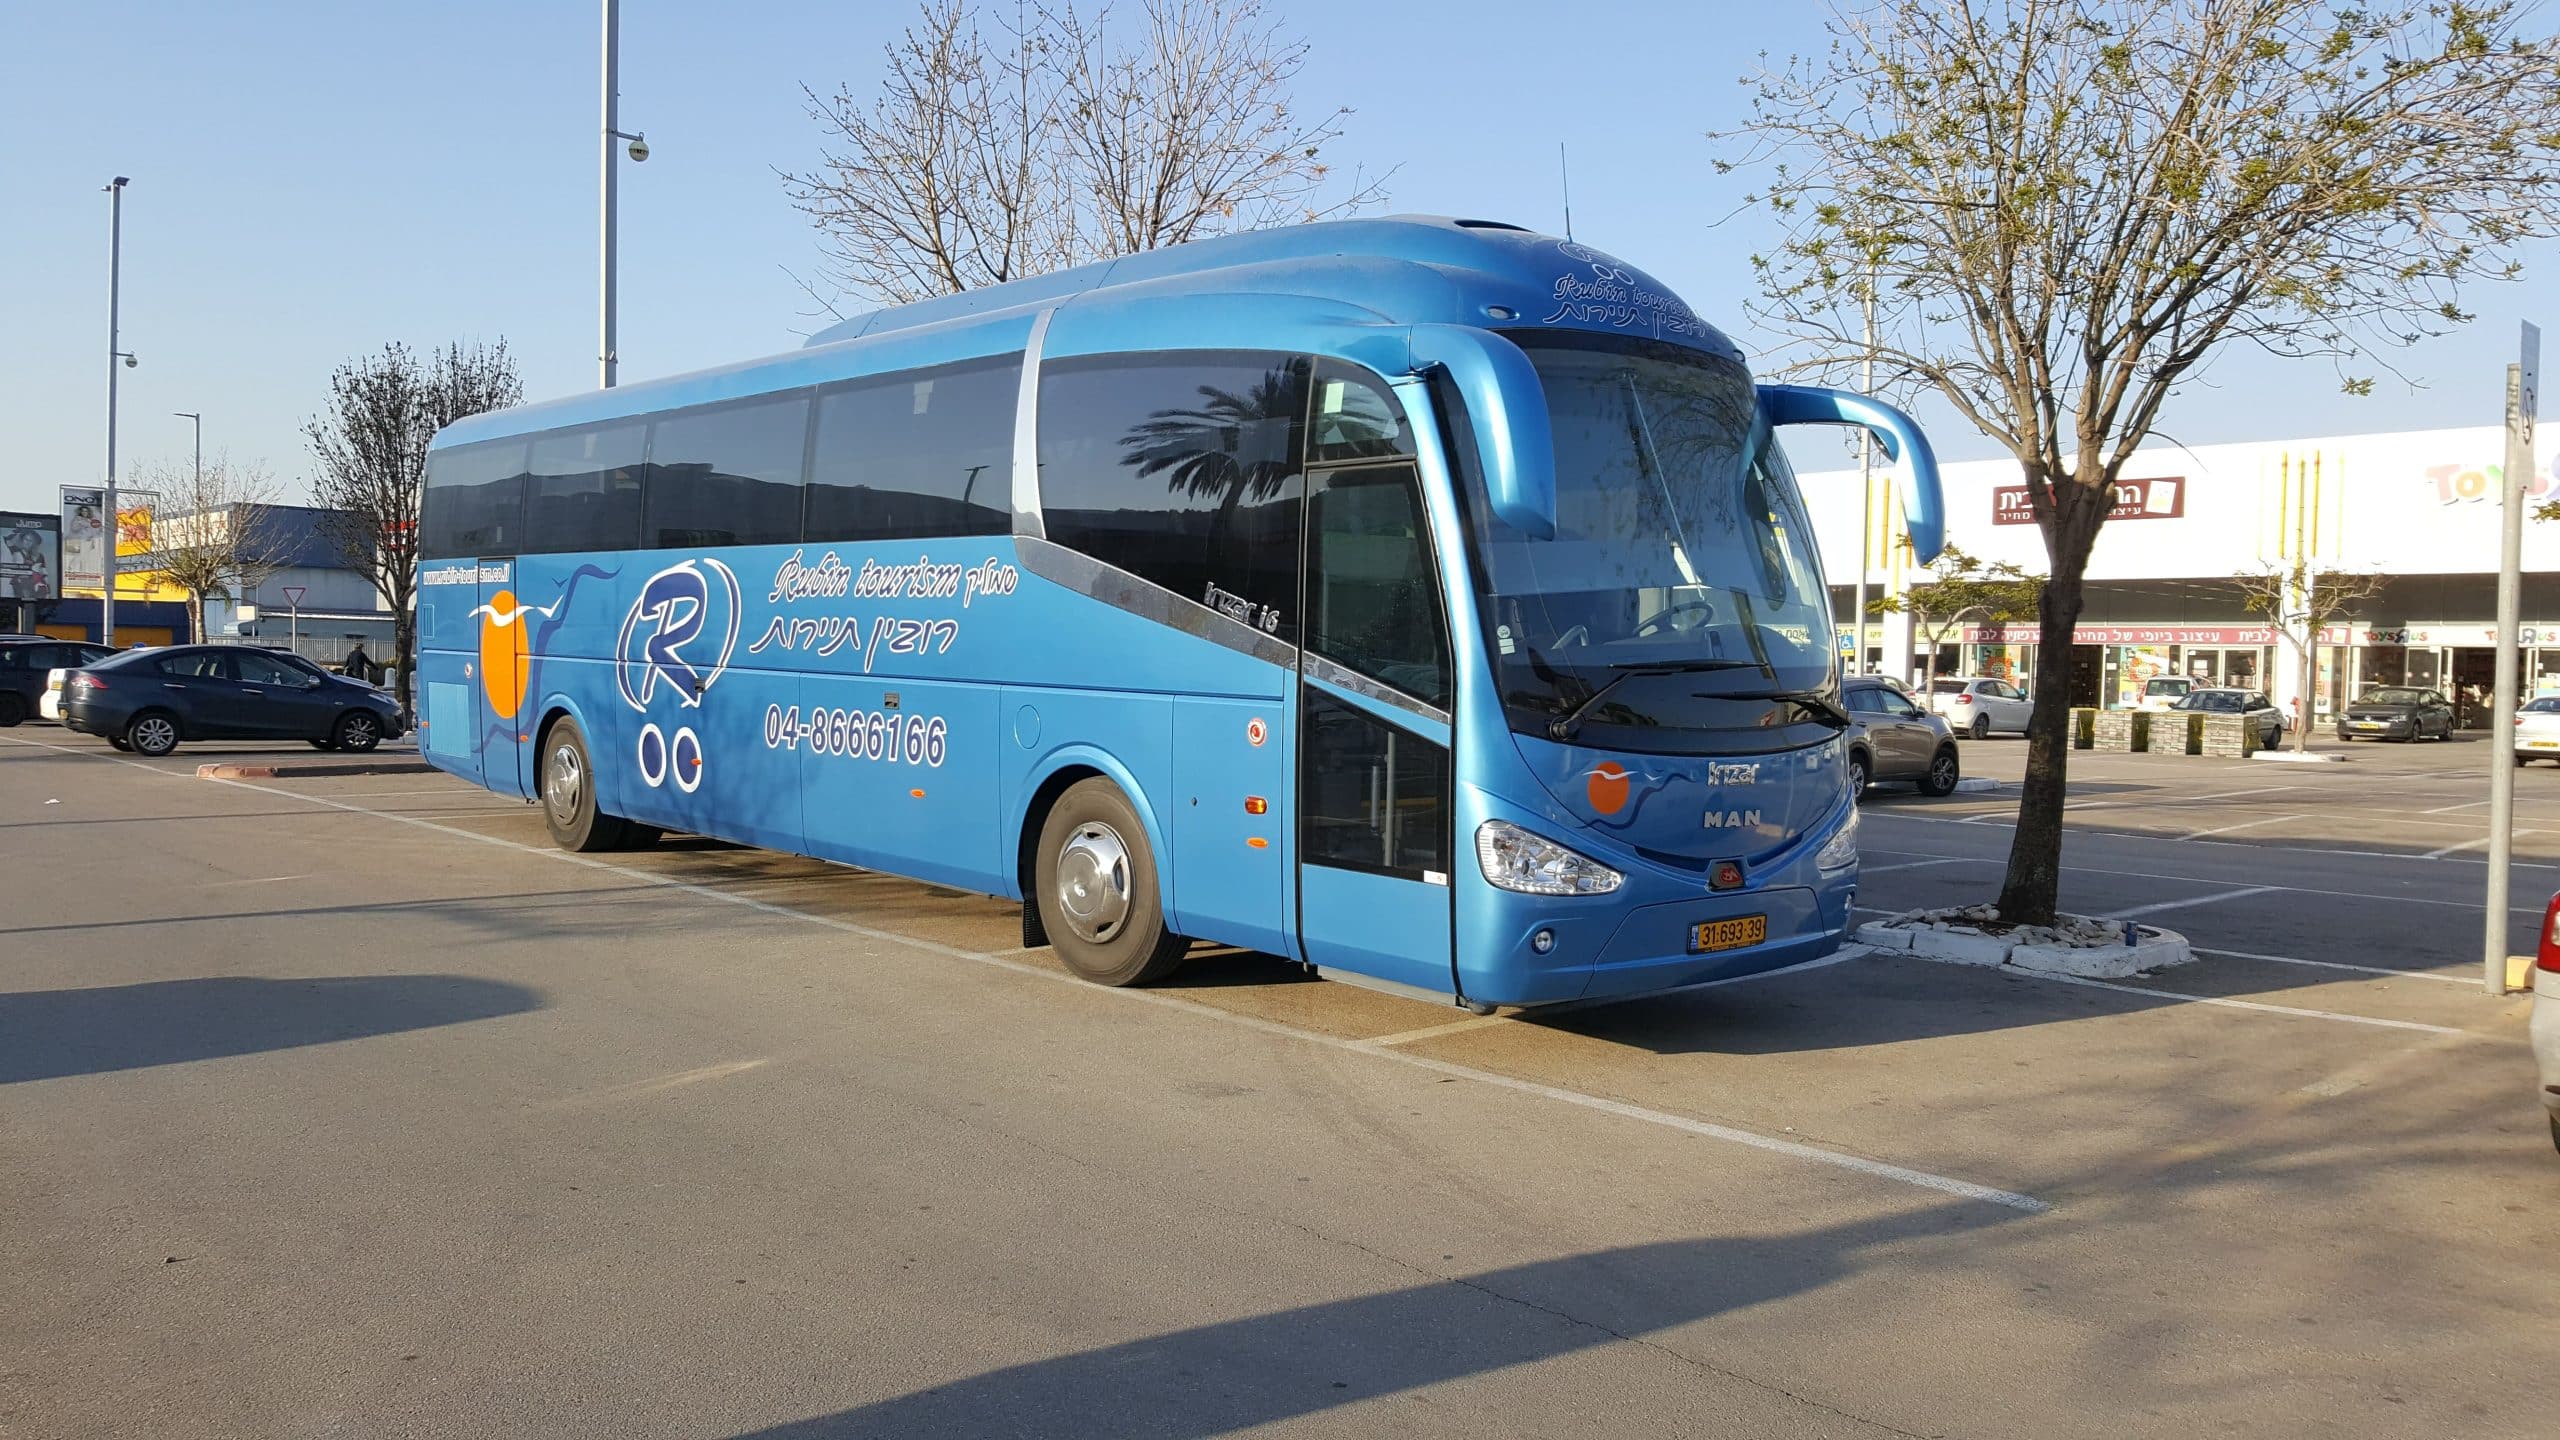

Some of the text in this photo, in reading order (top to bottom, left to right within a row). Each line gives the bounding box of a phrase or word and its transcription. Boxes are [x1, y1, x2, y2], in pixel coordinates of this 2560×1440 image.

[1553, 273, 1626, 302] Rubin
[1543, 301, 1648, 328] תיירות
[1999, 490, 2033, 510] בית
[1999, 507, 2141, 521] עיצו מחיר
[769, 549, 962, 602] Rubin tourism
[750, 615, 958, 673] רובין תיירות
[2073, 631, 2107, 641] מחיר
[2112, 629, 2133, 642] של
[2179, 631, 2220, 642] עיצוב
[2238, 628, 2271, 642] לבית
[765, 703, 947, 767] 04-8666166
[1707, 761, 1761, 786] Irizar
[1703, 809, 1761, 828] MAN
